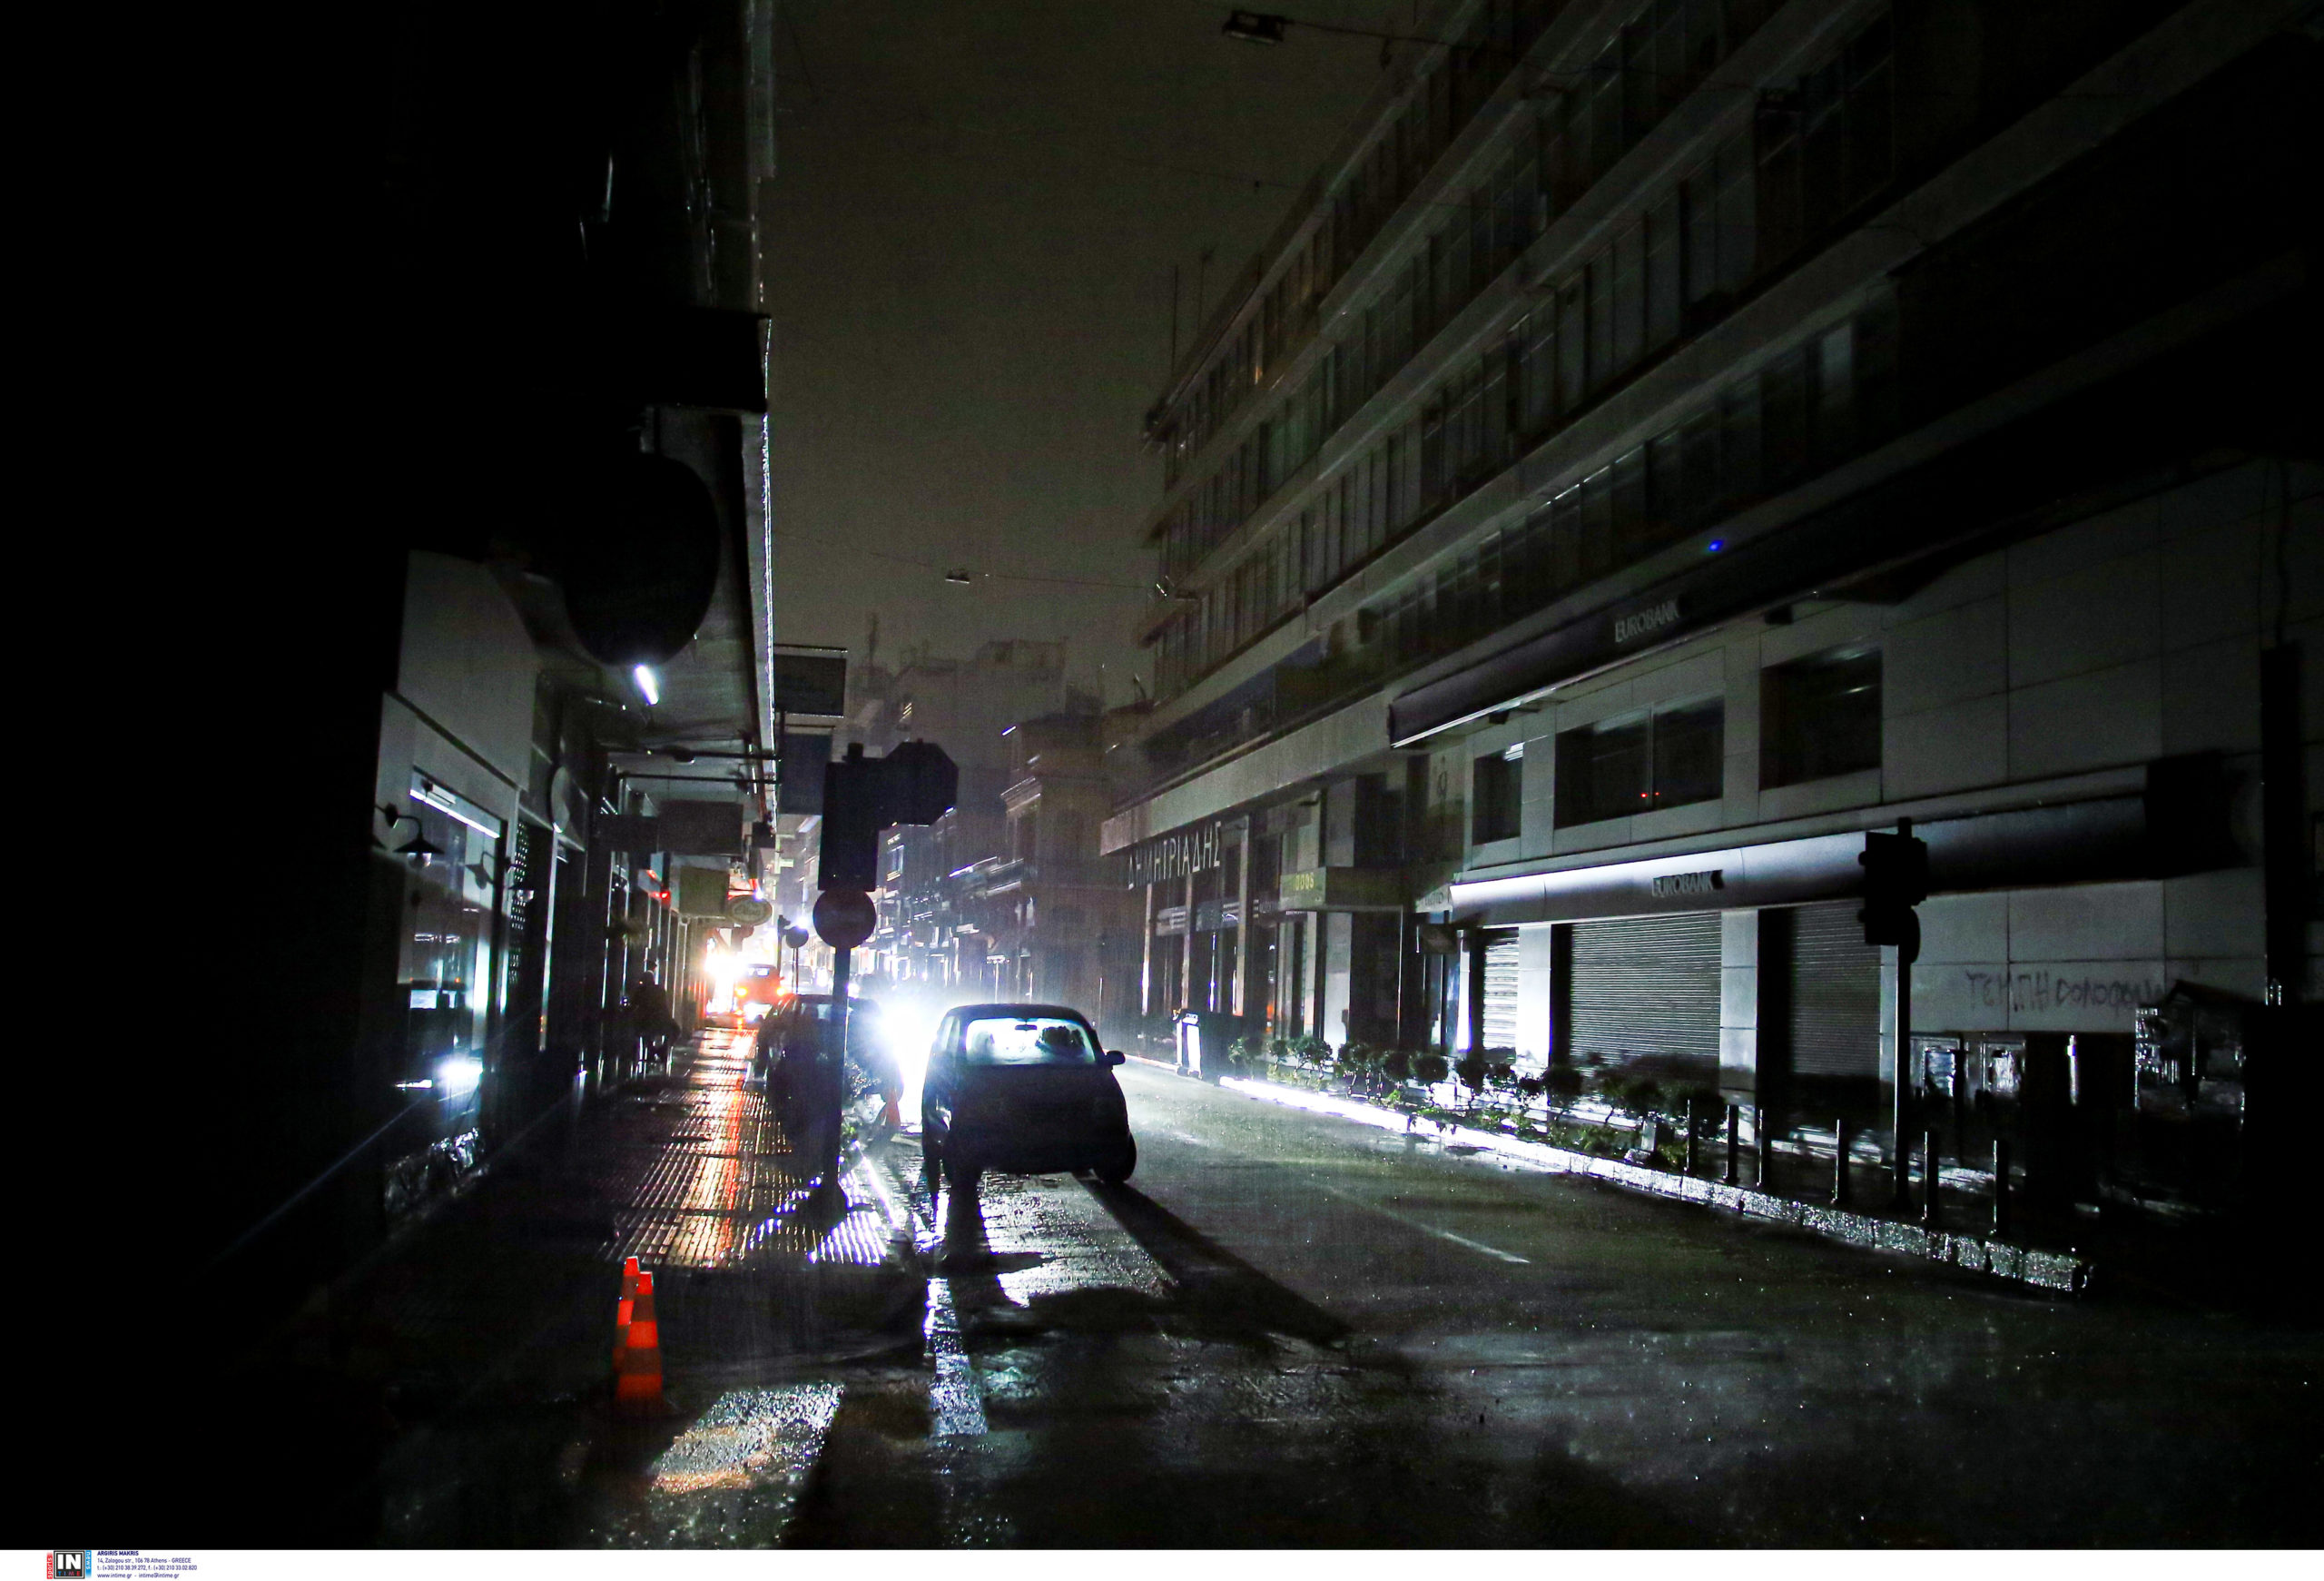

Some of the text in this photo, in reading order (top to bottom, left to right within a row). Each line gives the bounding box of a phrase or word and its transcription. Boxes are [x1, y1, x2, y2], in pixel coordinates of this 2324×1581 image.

[1614, 600, 1679, 643] EUROBANK
[1128, 820, 1222, 891] ΔΗΜΗΤΡΙΑΔΗΣ
[1651, 871, 1714, 898] EUROBANK
